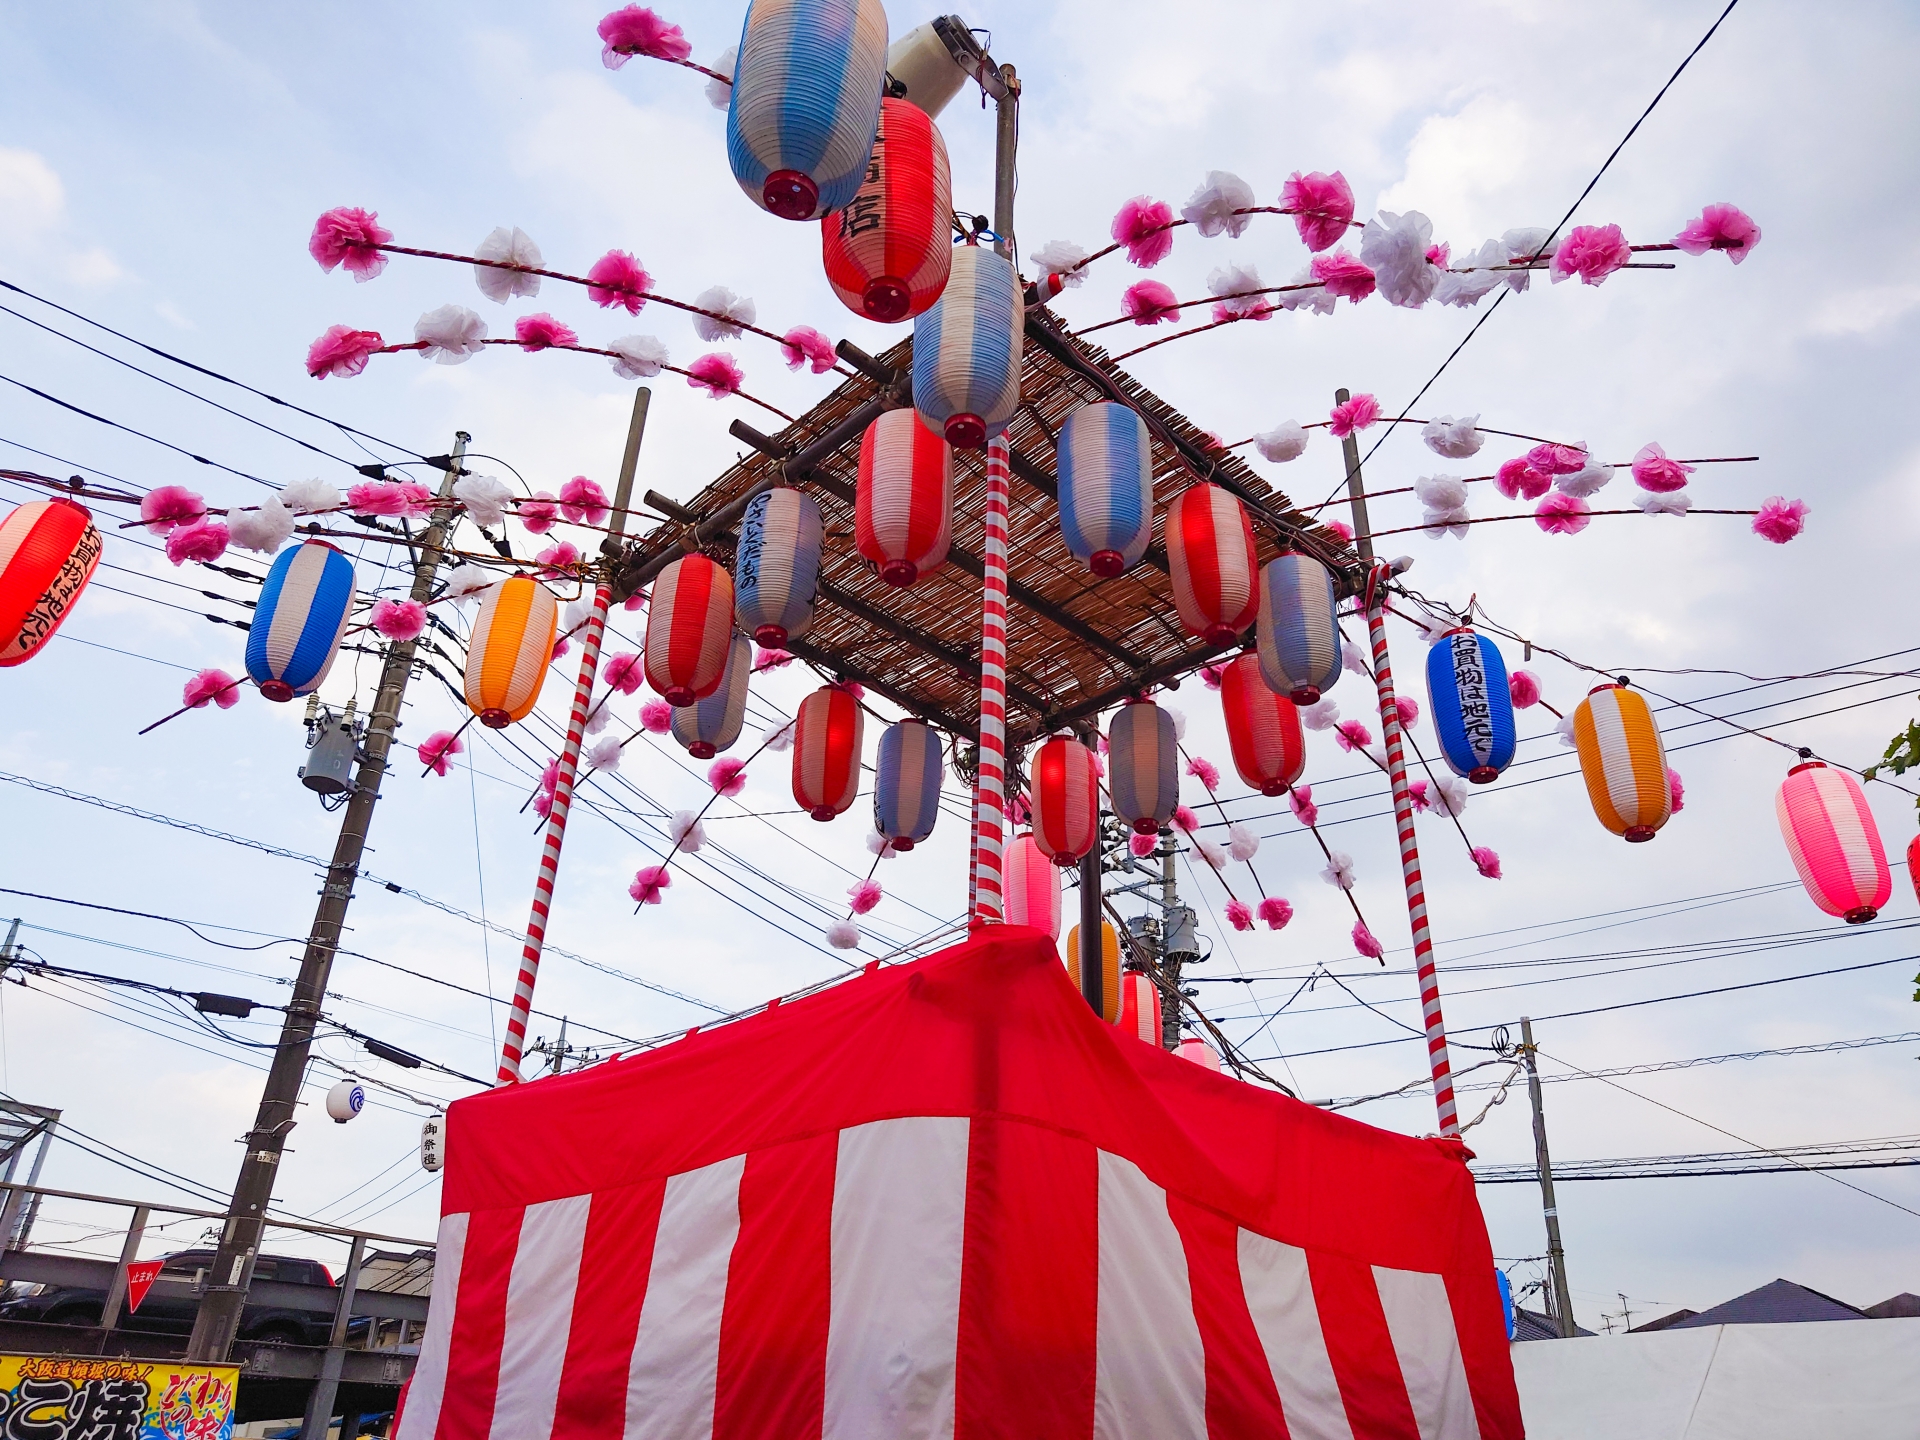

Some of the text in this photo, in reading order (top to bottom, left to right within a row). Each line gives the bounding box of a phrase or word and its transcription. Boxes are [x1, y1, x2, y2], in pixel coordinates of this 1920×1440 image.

[1450, 635, 1493, 753] お買物は地元で
[130, 1270, 154, 1284] 止まれ
[0, 1377, 150, 1440] こ焼
